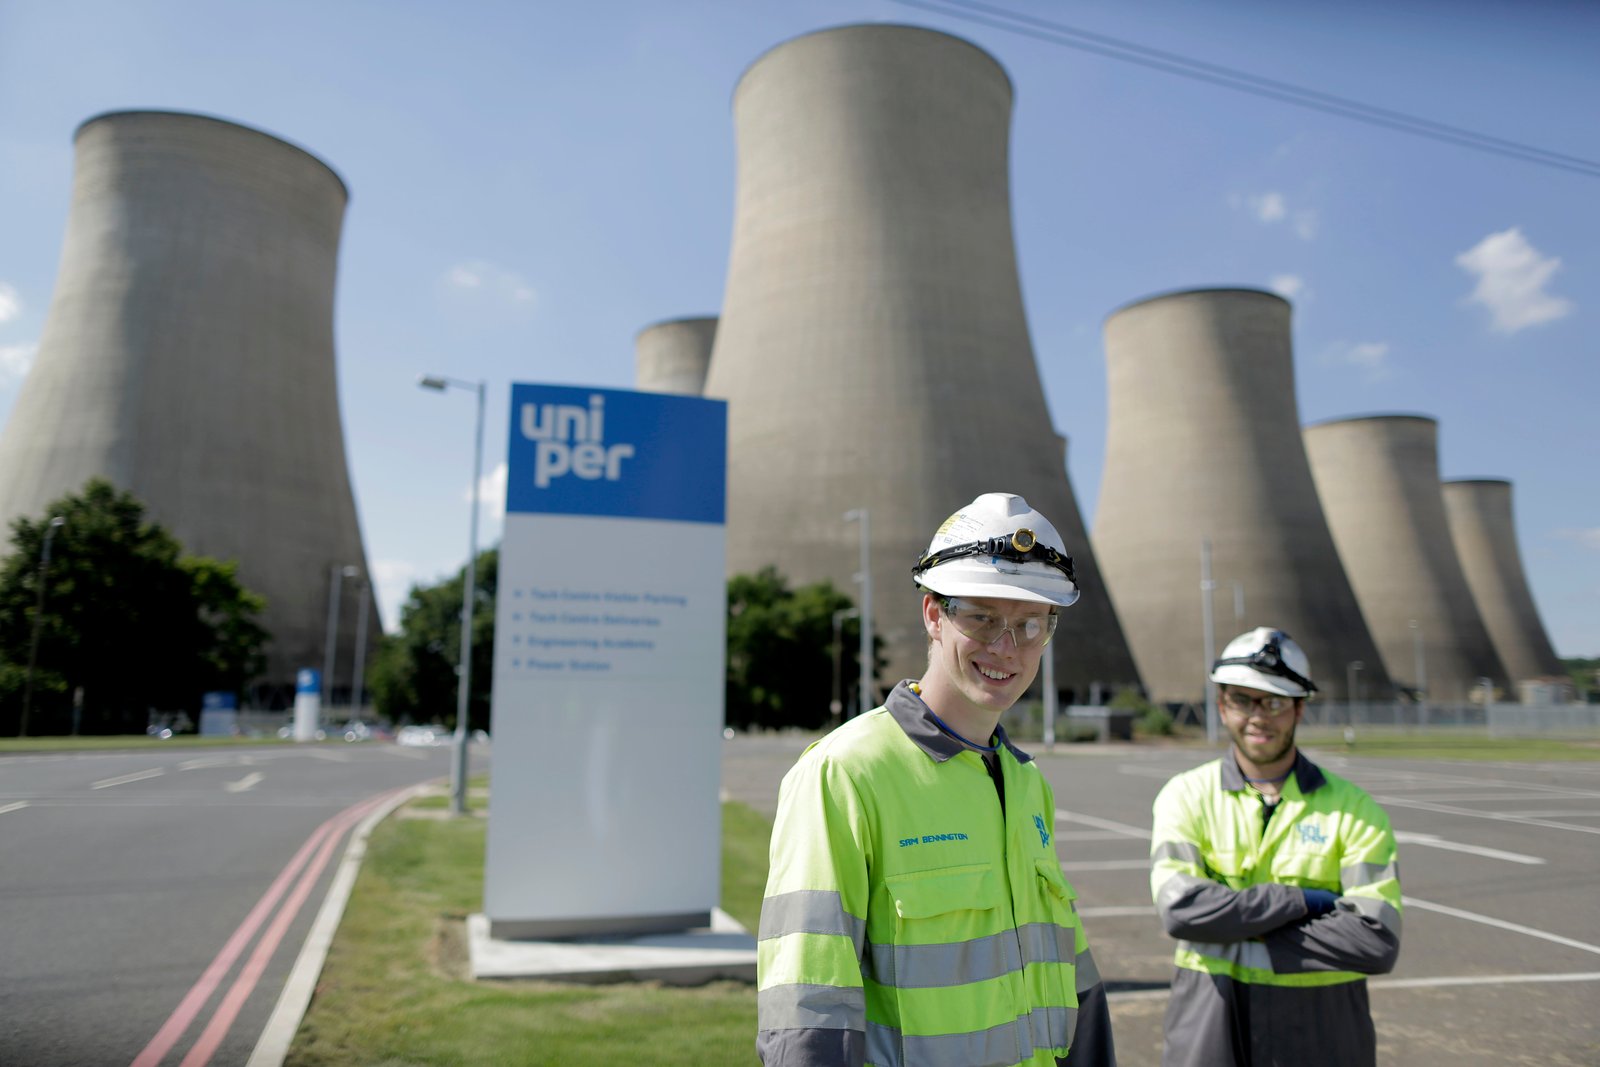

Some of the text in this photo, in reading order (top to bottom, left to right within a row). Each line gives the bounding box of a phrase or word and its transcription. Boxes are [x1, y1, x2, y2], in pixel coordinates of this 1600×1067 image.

[520, 394, 604, 442] uni
[534, 441, 635, 489] per
[527, 635, 599, 650] Engineering
[527, 657, 611, 671] Power Station
[899, 833, 969, 847] SAM BENNINGTON
